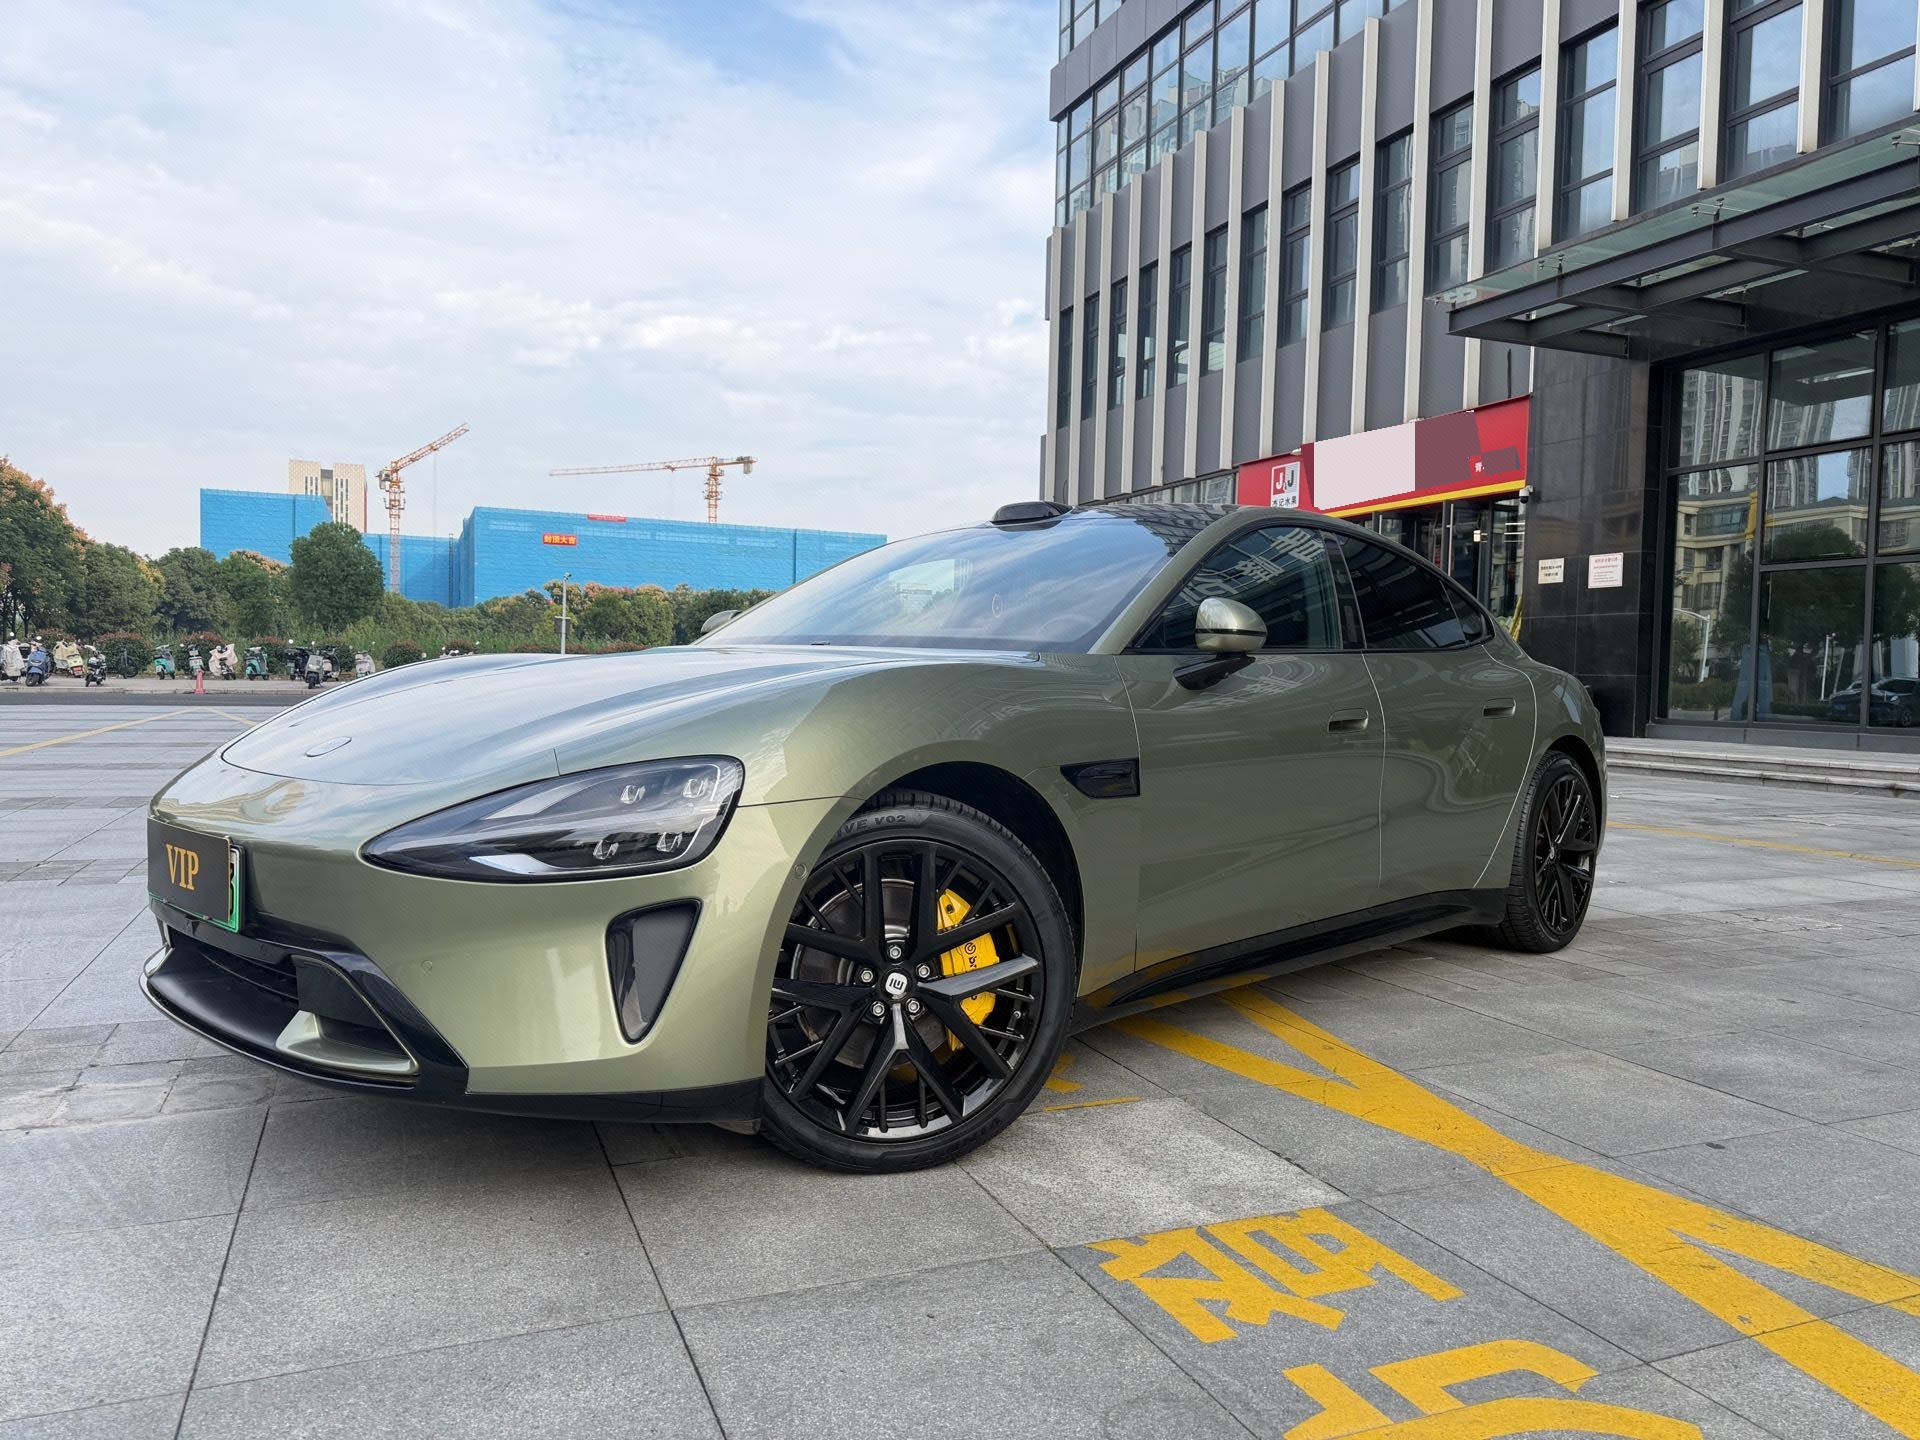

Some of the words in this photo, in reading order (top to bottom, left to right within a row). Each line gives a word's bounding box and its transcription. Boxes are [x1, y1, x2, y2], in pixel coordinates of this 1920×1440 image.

[543, 534, 576, 545] 封顶大吉
[166, 844, 199, 890] VIP
